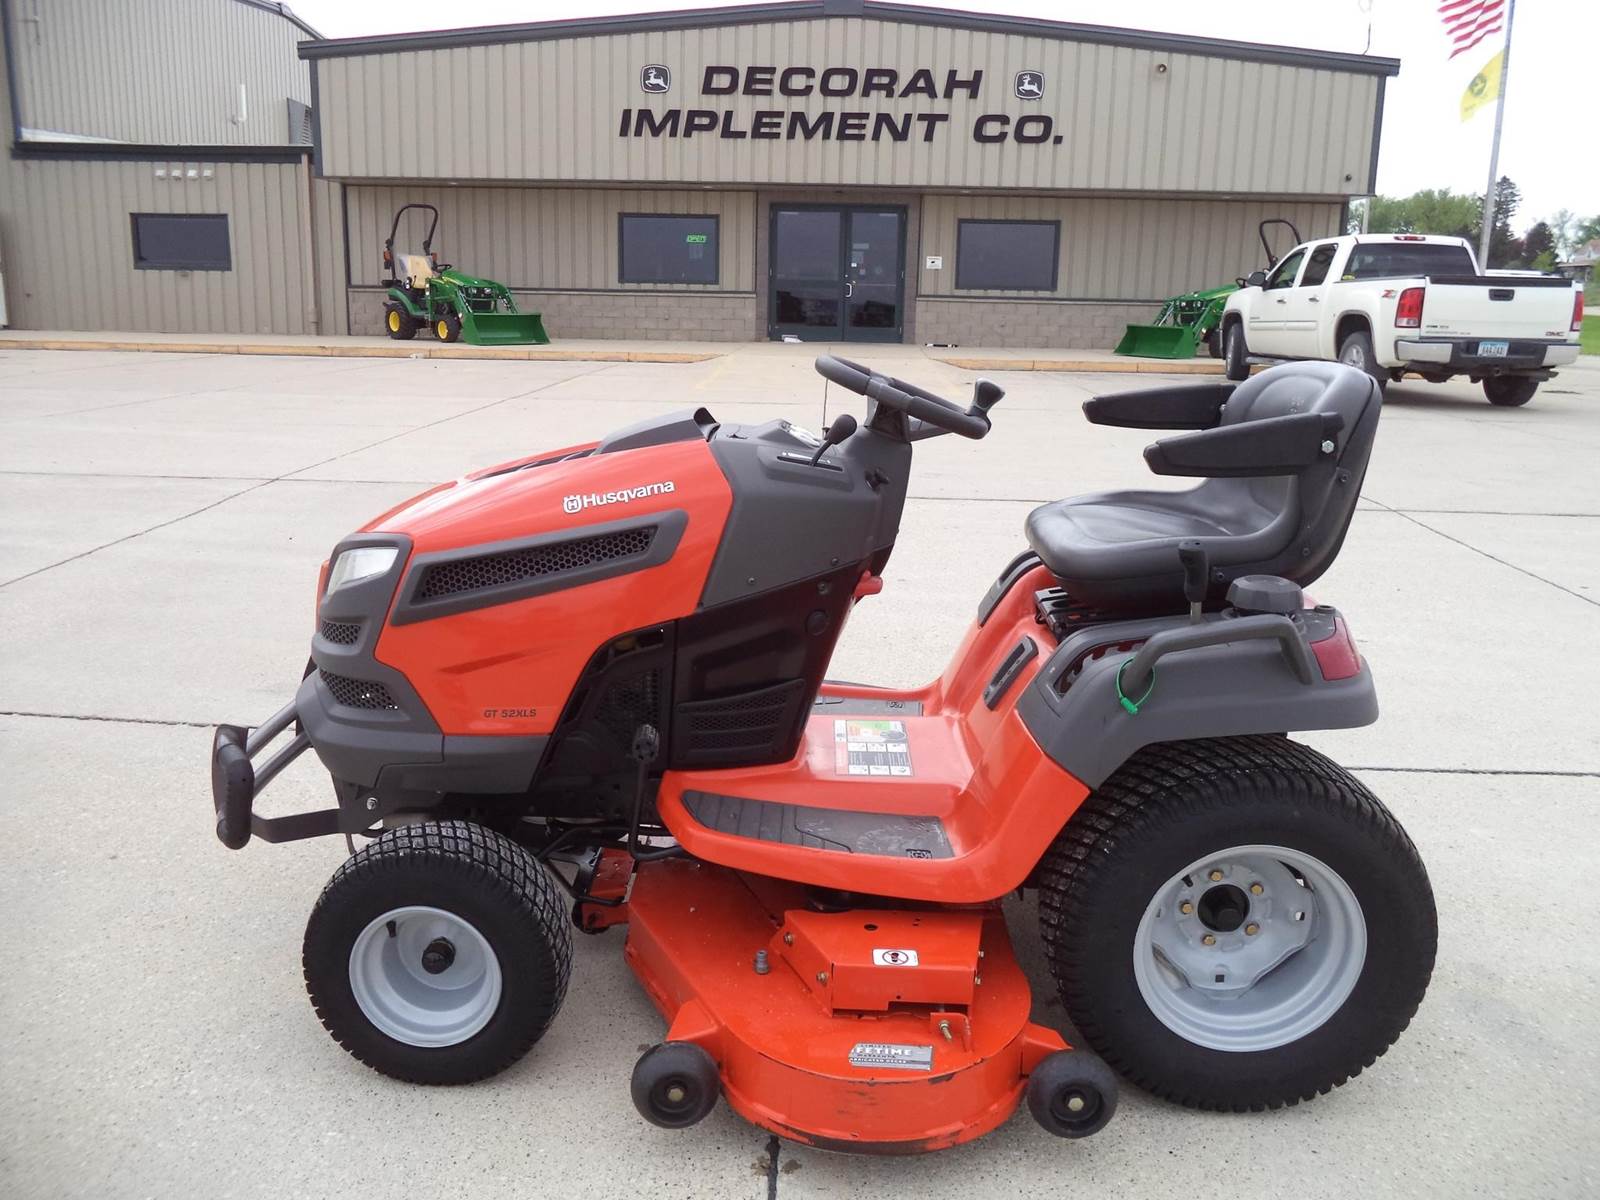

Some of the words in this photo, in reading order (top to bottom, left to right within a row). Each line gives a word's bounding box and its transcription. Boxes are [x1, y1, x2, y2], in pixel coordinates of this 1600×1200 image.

[701, 65, 983, 100] DECORAH
[618, 108, 949, 143] IMPLEMENT
[972, 113, 1064, 146] CO.
[583, 481, 675, 508] Husqvarna
[484, 709, 498, 719] GT
[501, 708, 537, 719] 52XLS
